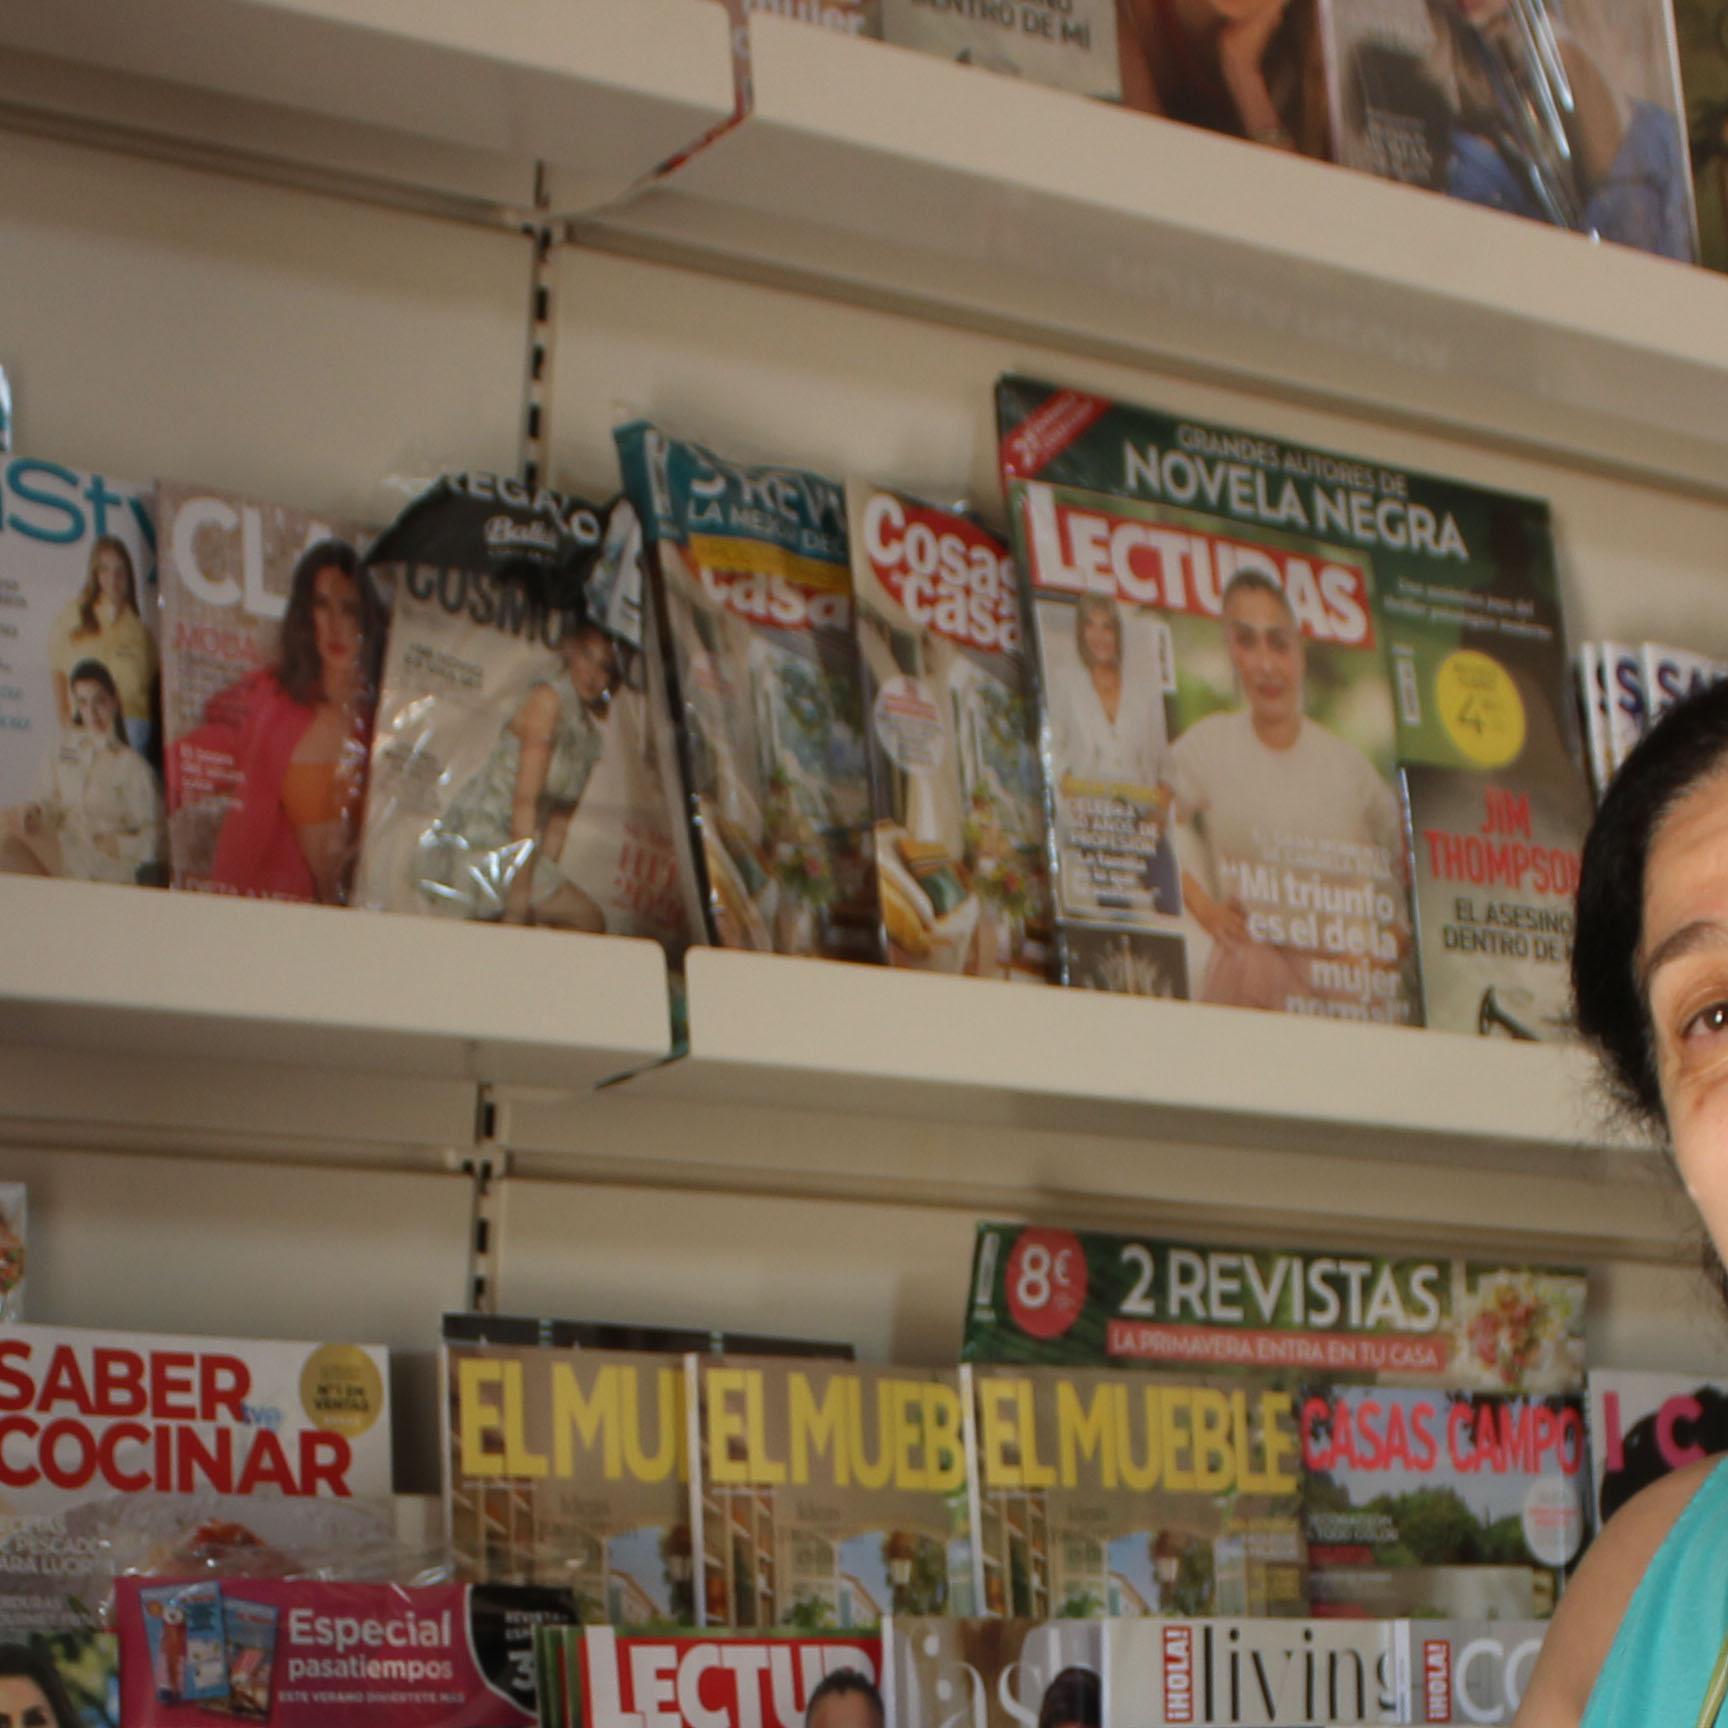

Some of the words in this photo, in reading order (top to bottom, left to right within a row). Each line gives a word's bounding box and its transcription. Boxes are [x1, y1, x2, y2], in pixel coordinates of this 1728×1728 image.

[1125, 442, 1307, 521] NOVELA
[1314, 491, 1468, 560] NEGRA
[1481, 787, 1530, 836] JIM
[1425, 829, 1580, 894] THOMPSON
[1119, 1245, 1156, 1315] 2
[1167, 1252, 1441, 1333] REVISTAS
[1112, 1329, 1135, 1353] LA
[1136, 1330, 1253, 1361] PRIMAVERA
[1257, 1336, 1324, 1363] ENTRA
[1329, 1340, 1358, 1363] EN
[1360, 1340, 1388, 1363] TU
[1390, 1342, 1440, 1368] CASA
[980, 1377, 1054, 1489] EL
[1054, 1380, 1298, 1494] MUEBLE
[1300, 1397, 1435, 1473] CASAS
[1447, 1399, 1585, 1475] CAMPO
[288, 1609, 452, 1651] Especial
[288, 1655, 454, 1683] pasatiempos
[1164, 1627, 1193, 1722] ¡HOLA!
